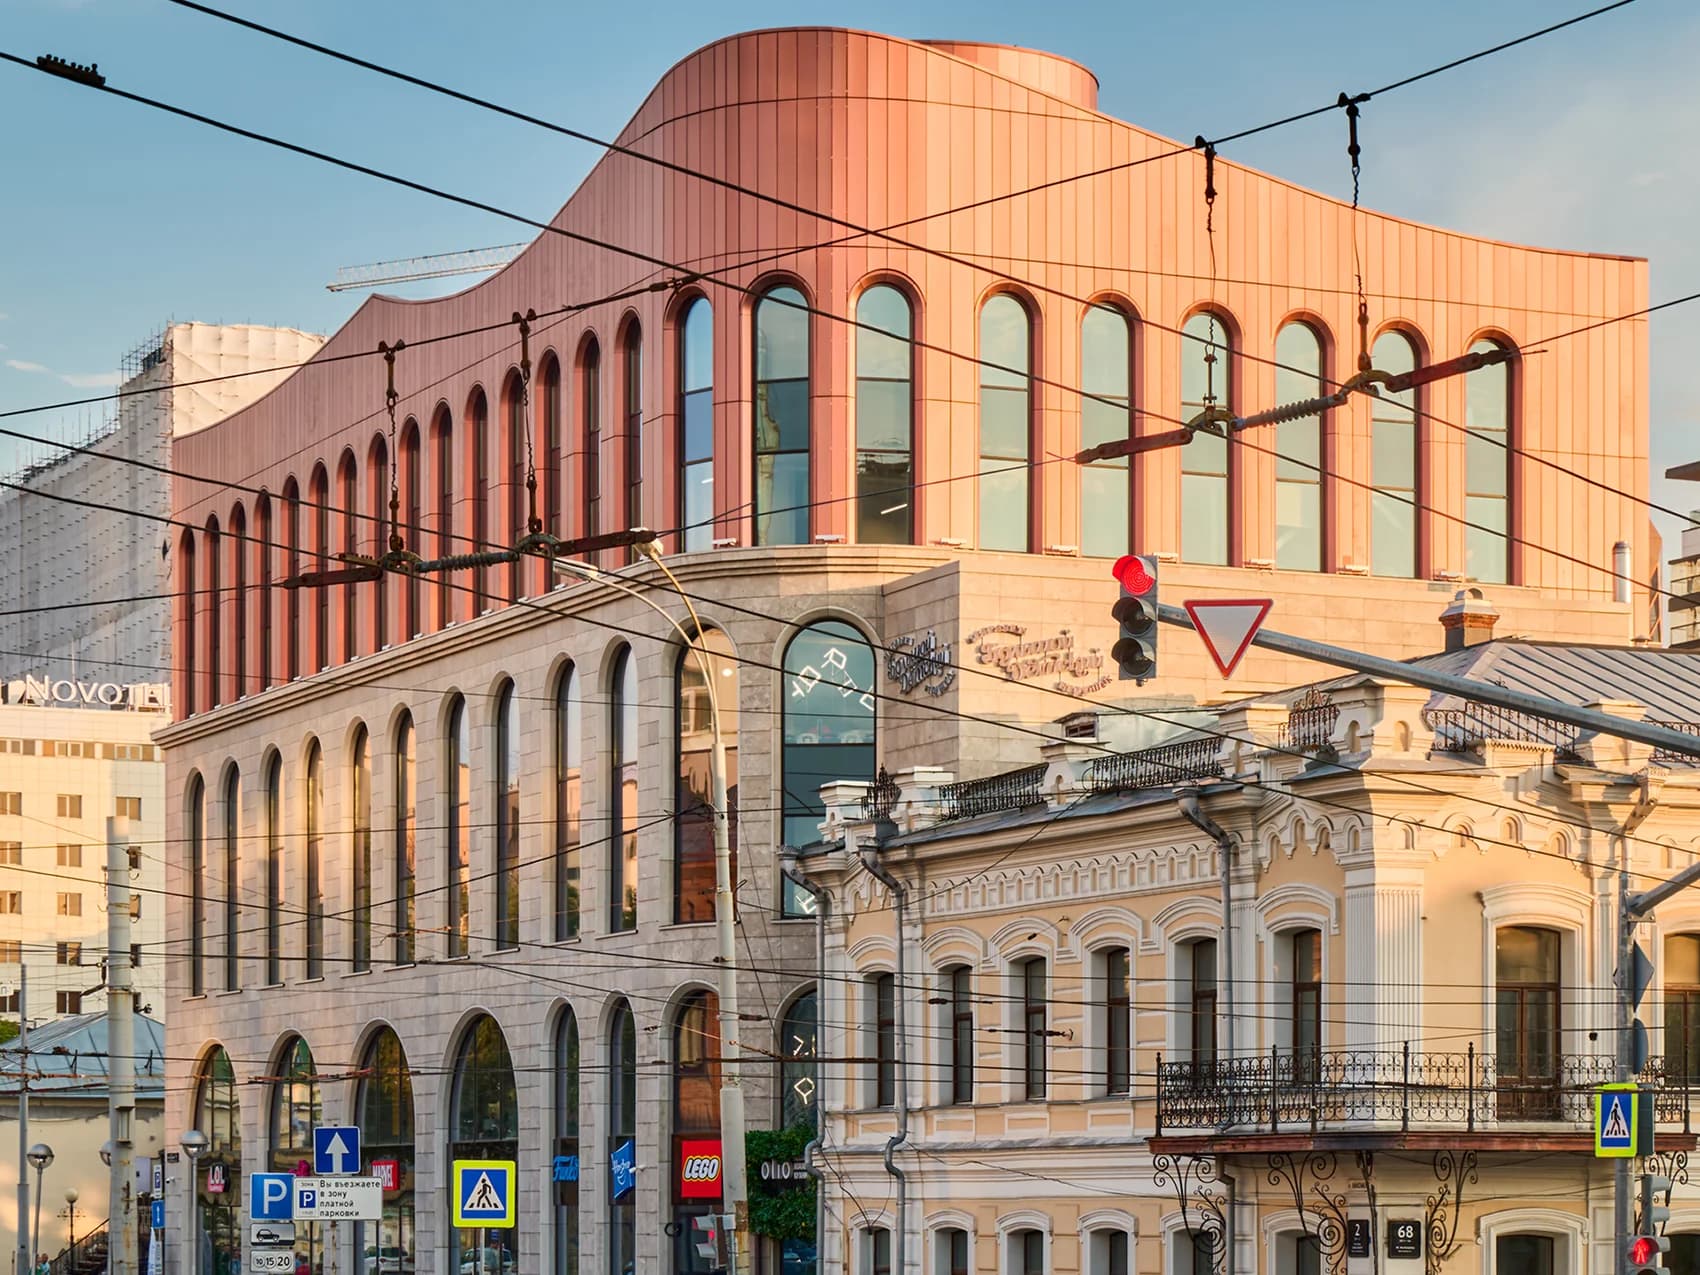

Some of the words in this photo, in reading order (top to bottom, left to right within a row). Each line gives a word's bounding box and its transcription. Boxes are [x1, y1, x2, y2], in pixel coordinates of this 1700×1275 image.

[210, 1165, 225, 1184] LOL
[684, 1159, 719, 1179] LEGO
[320, 1180, 332, 1188] Вы
[328, 1191, 347, 1199] зону
[320, 1210, 360, 1218] парковки
[1354, 1223, 1361, 1237] 2
[1397, 1225, 1414, 1238] 68
[266, 1256, 275, 1266] 15
[277, 1256, 290, 1266] 20
